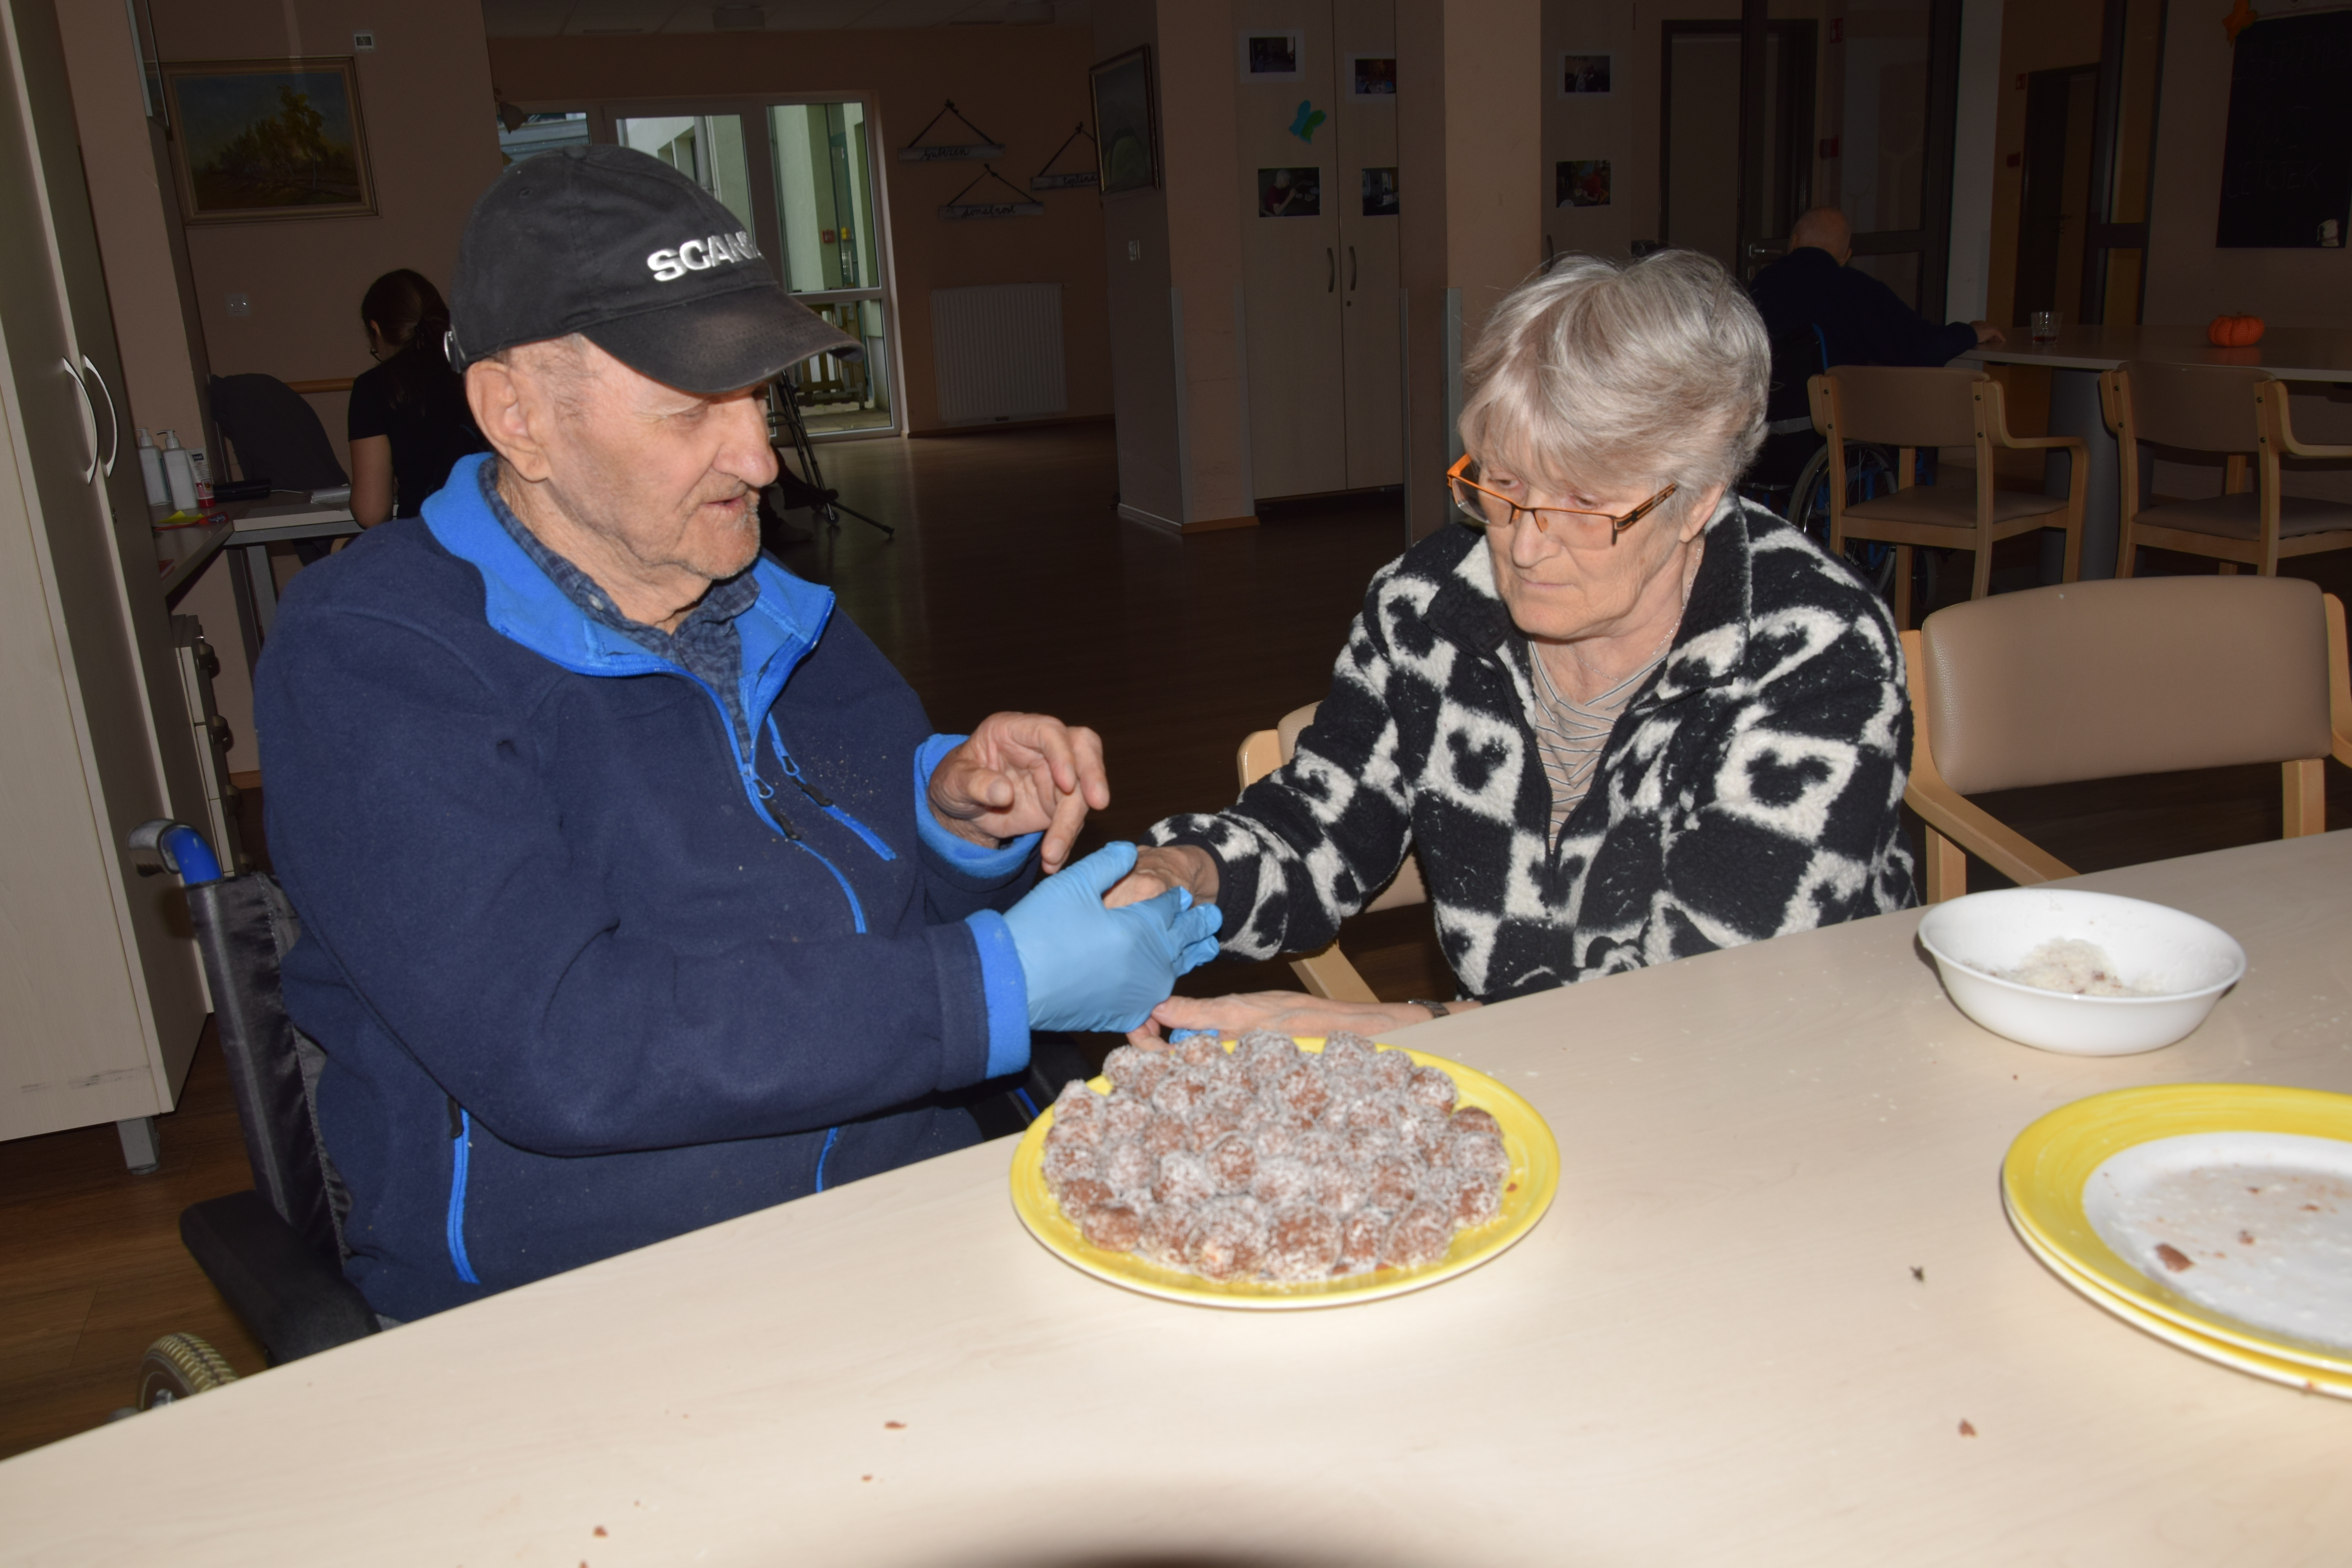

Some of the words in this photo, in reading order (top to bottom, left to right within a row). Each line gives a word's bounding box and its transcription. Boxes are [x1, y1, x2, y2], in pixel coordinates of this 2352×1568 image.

[1063, 174, 1098, 188] toplina
[962, 205, 1016, 218] domačnost
[647, 230, 762, 281] SCAN
